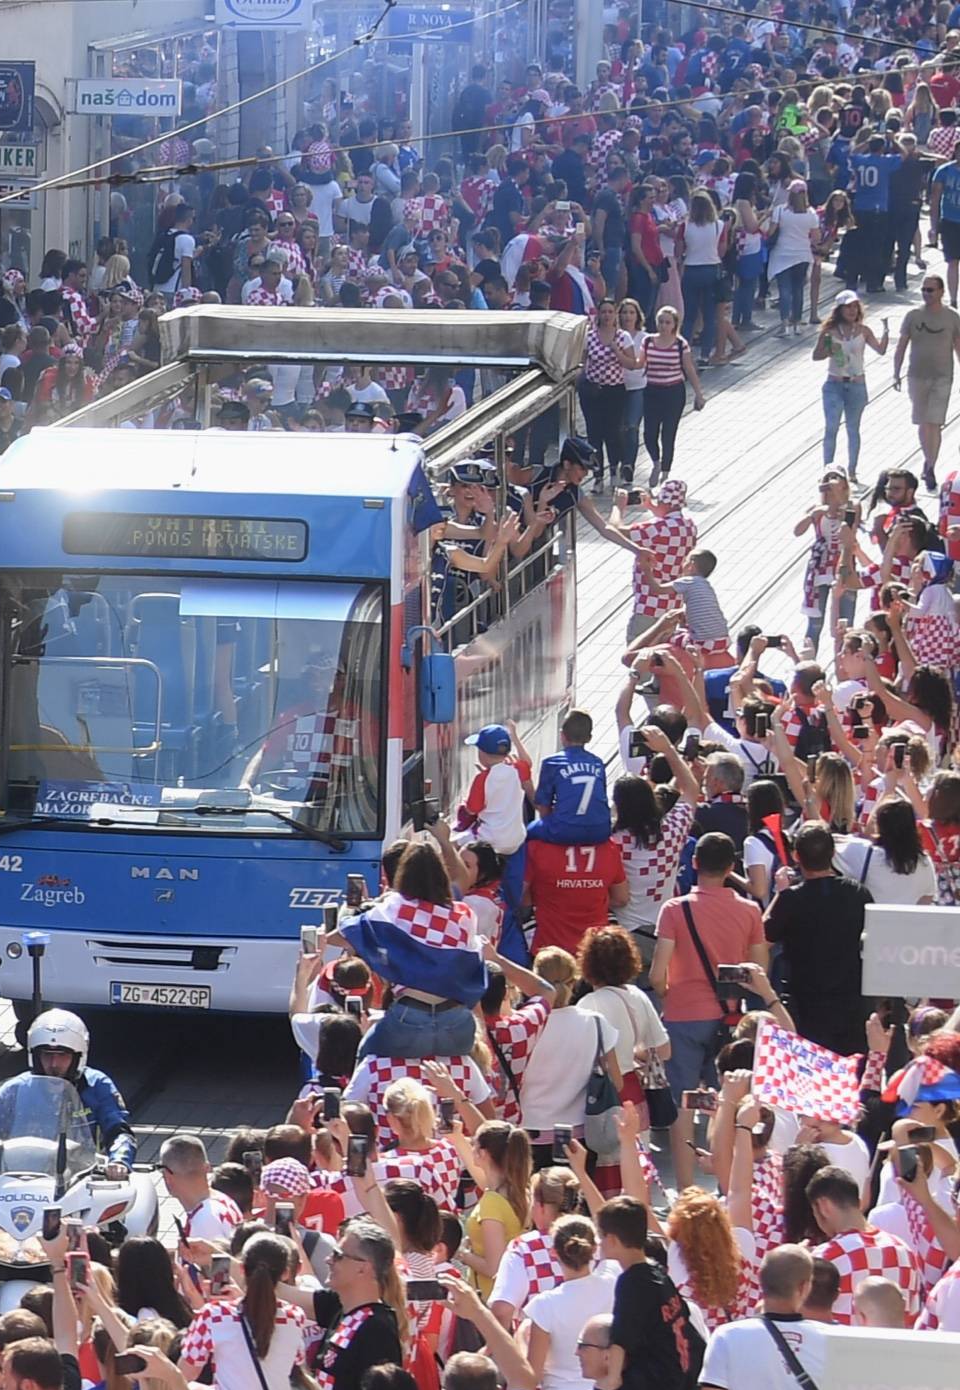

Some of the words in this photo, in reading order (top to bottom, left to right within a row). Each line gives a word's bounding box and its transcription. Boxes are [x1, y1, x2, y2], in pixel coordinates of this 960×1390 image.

[81, 88, 115, 107] naš
[135, 89, 177, 107] dom
[856, 164, 878, 188] 10
[570, 775, 597, 816] 7
[565, 846, 596, 873] 17
[131, 866, 199, 881] MAN
[556, 879, 604, 889] HRVATSKA
[20, 882, 86, 908] Zagreb
[122, 985, 141, 1003] ZG
